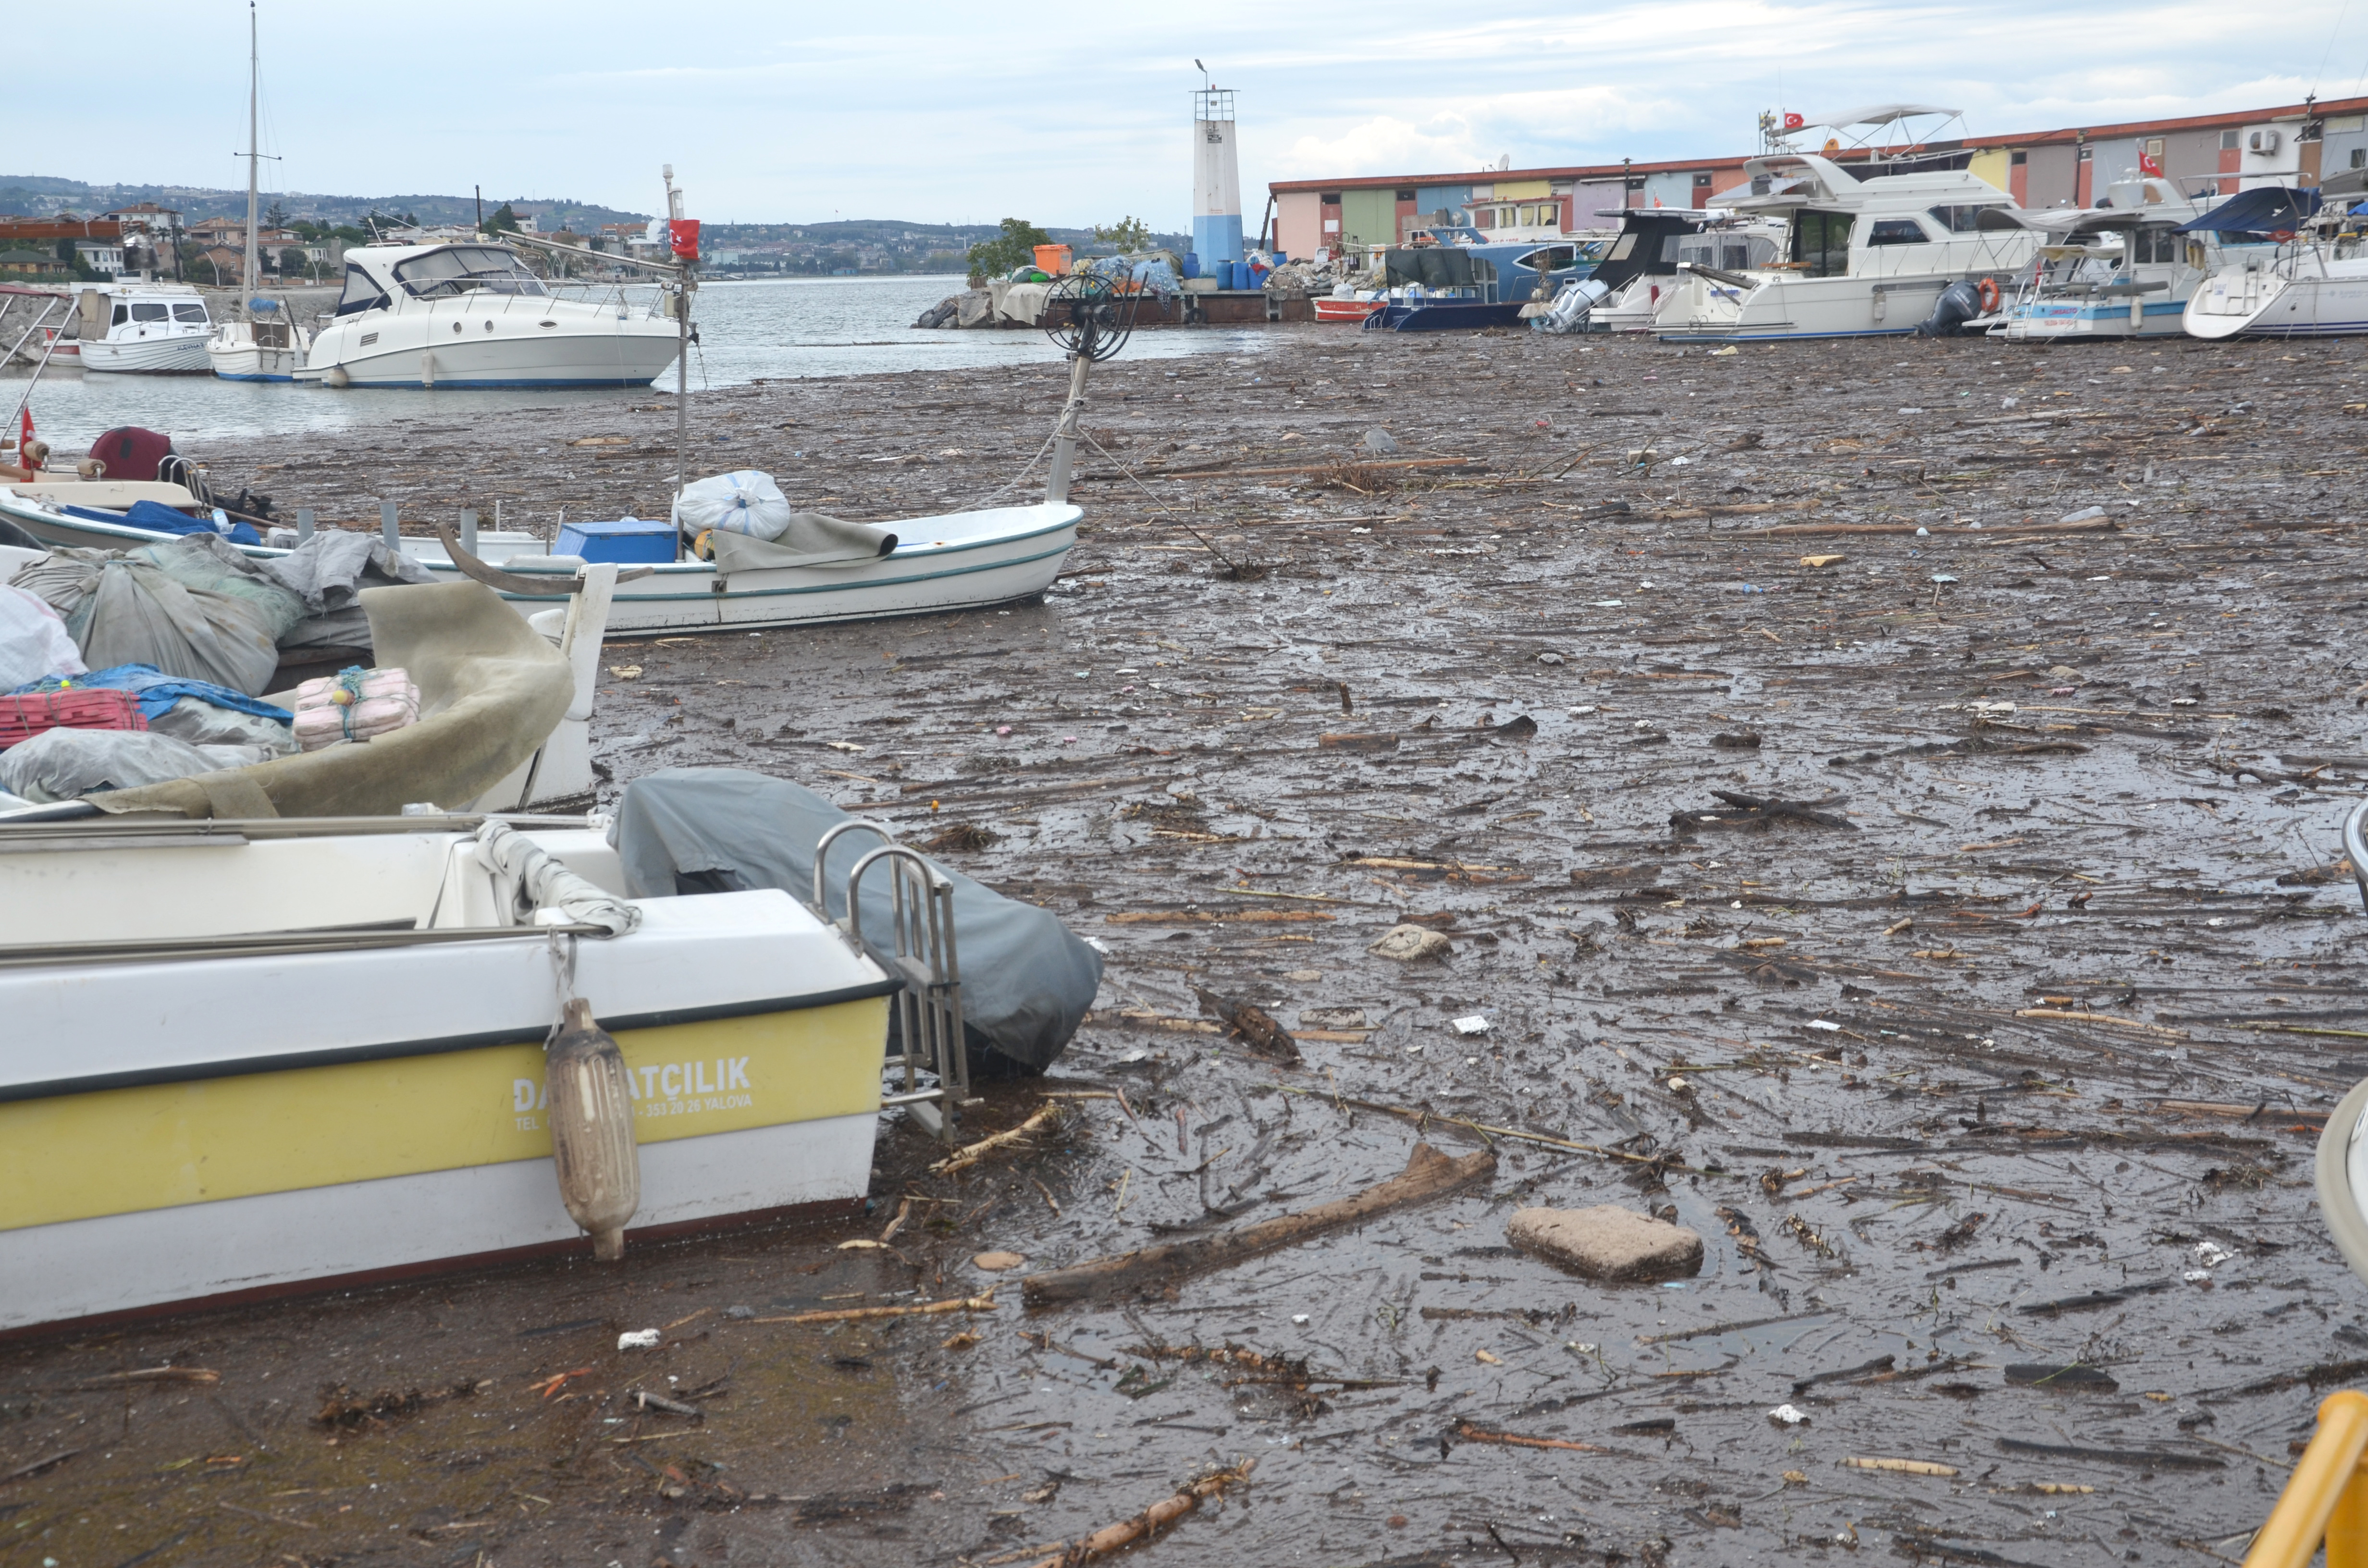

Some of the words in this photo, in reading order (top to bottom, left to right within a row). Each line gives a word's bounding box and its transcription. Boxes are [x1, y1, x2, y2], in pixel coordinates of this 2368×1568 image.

[515, 1116, 540, 1131] TEL
[646, 1102, 667, 1117] 353
[670, 1100, 684, 1115] 20
[687, 1099, 701, 1114] 26
[704, 1093, 752, 1111] YALOVA
